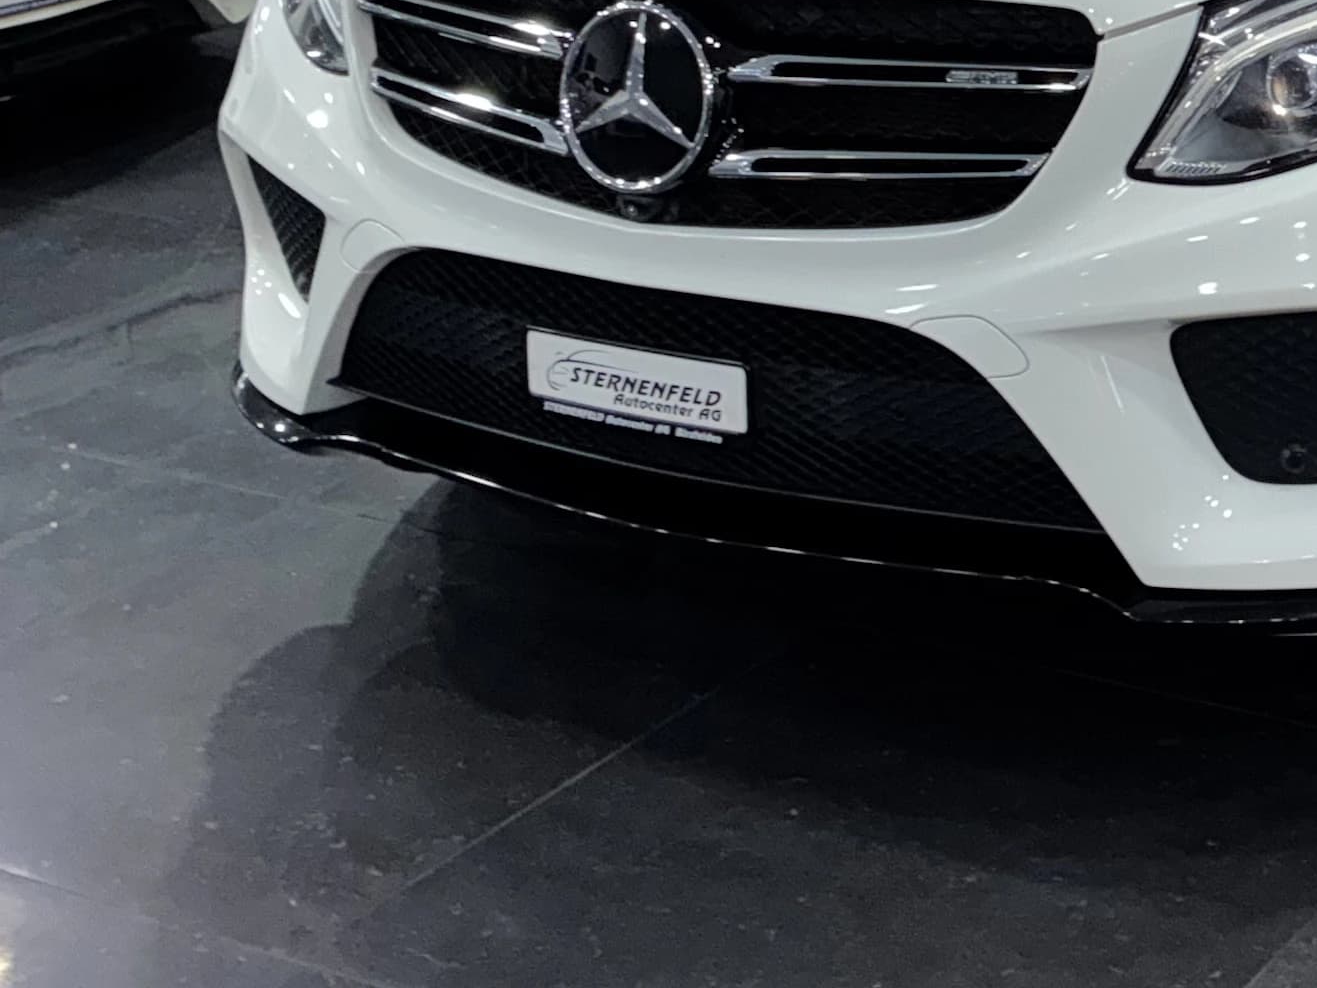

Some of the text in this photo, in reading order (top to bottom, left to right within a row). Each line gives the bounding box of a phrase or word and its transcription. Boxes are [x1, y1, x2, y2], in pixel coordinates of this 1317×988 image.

[570, 366, 722, 407] STERNENFELD
[613, 393, 694, 418] Autocenter
[699, 407, 722, 423] AG
